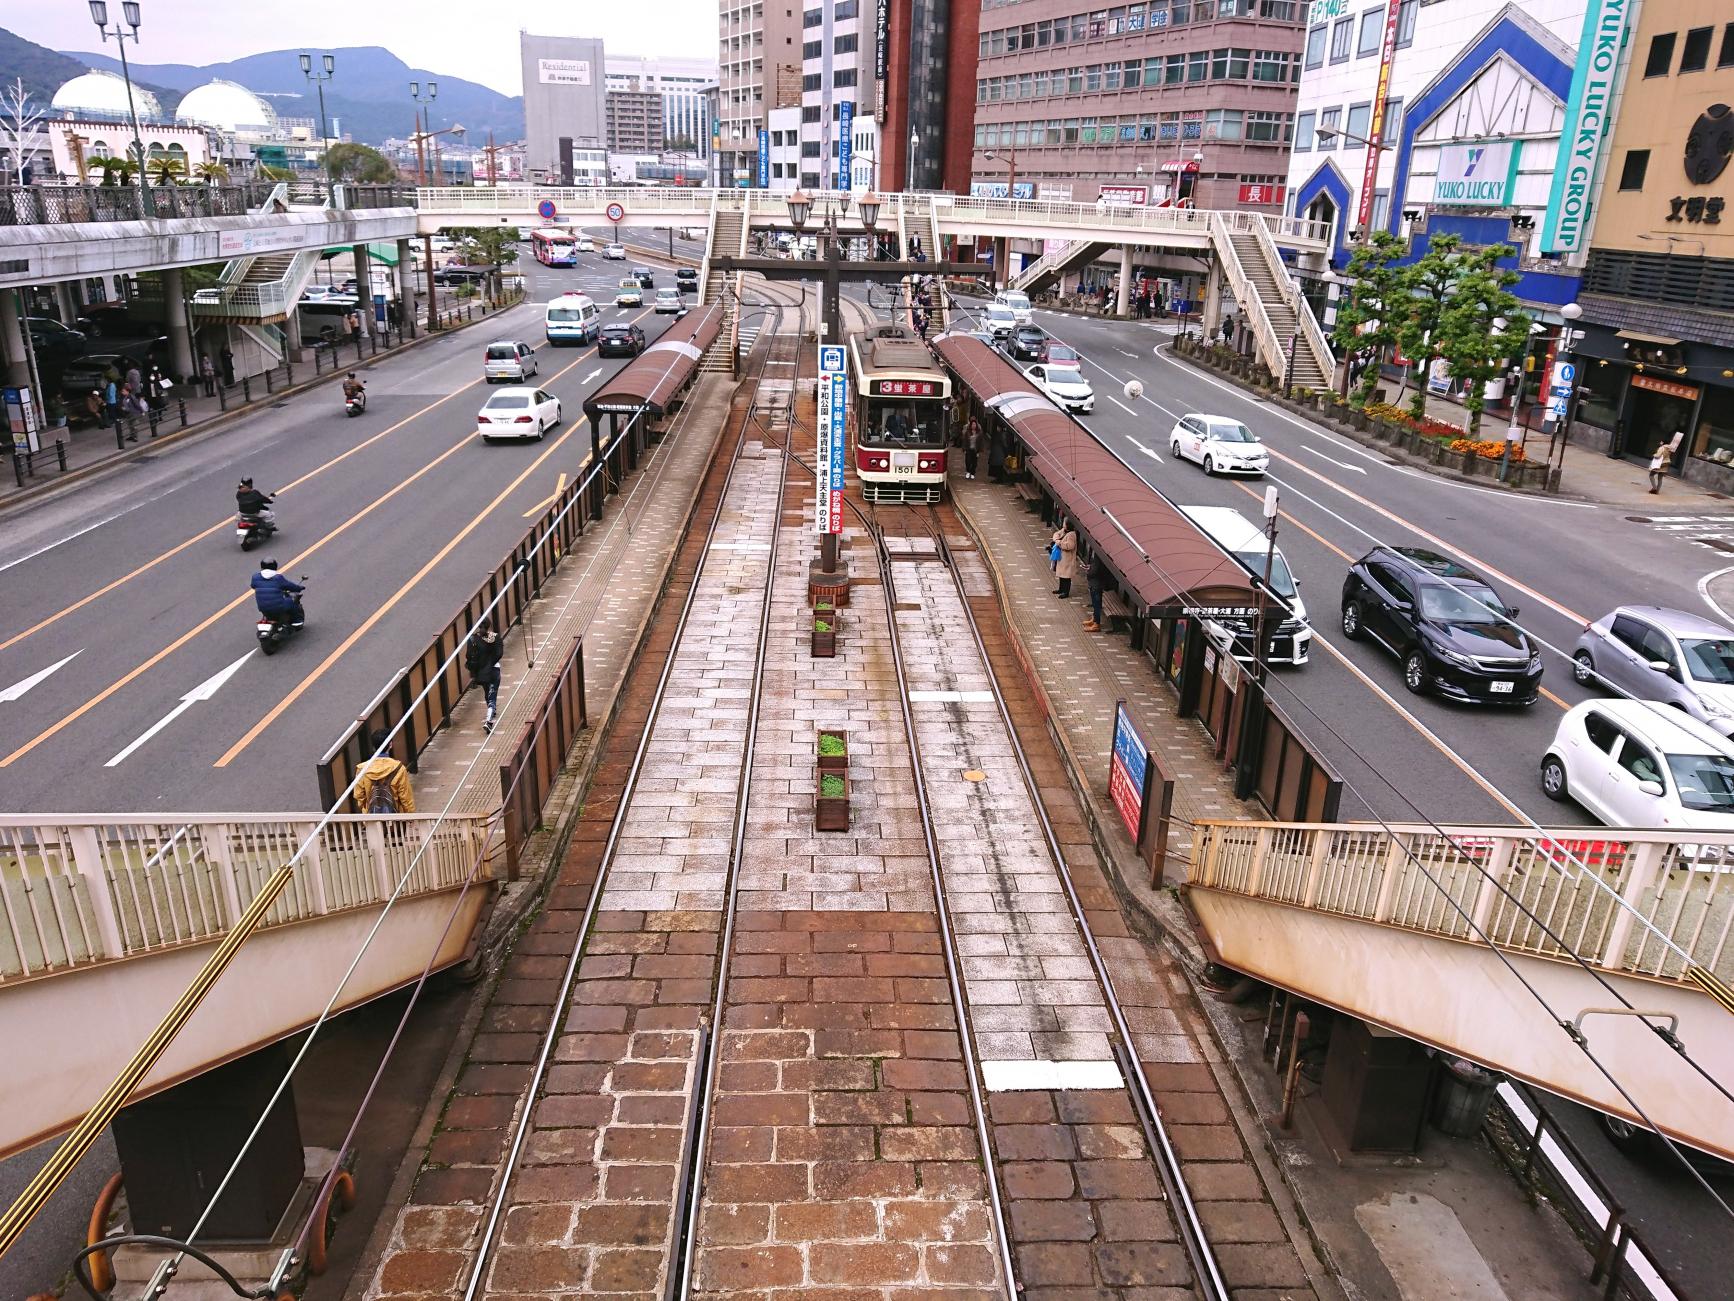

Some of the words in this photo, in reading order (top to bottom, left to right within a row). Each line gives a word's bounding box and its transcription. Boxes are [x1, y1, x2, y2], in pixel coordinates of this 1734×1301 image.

[1594, 0, 1624, 73] YUKO
[542, 61, 587, 72] Residential
[1576, 80, 1606, 160] LUCKY
[840, 112, 849, 191] 長崎医療こども専門学
[1247, 186, 1261, 202] 長
[1437, 182, 1464, 200] YUKO
[1466, 180, 1505, 200] LUCKY
[610, 208, 620, 217] 50
[1559, 166, 1588, 247] GROUP
[1665, 196, 1725, 224] 文明堂
[882, 381, 892, 393] 3
[831, 515, 841, 531] のりば
